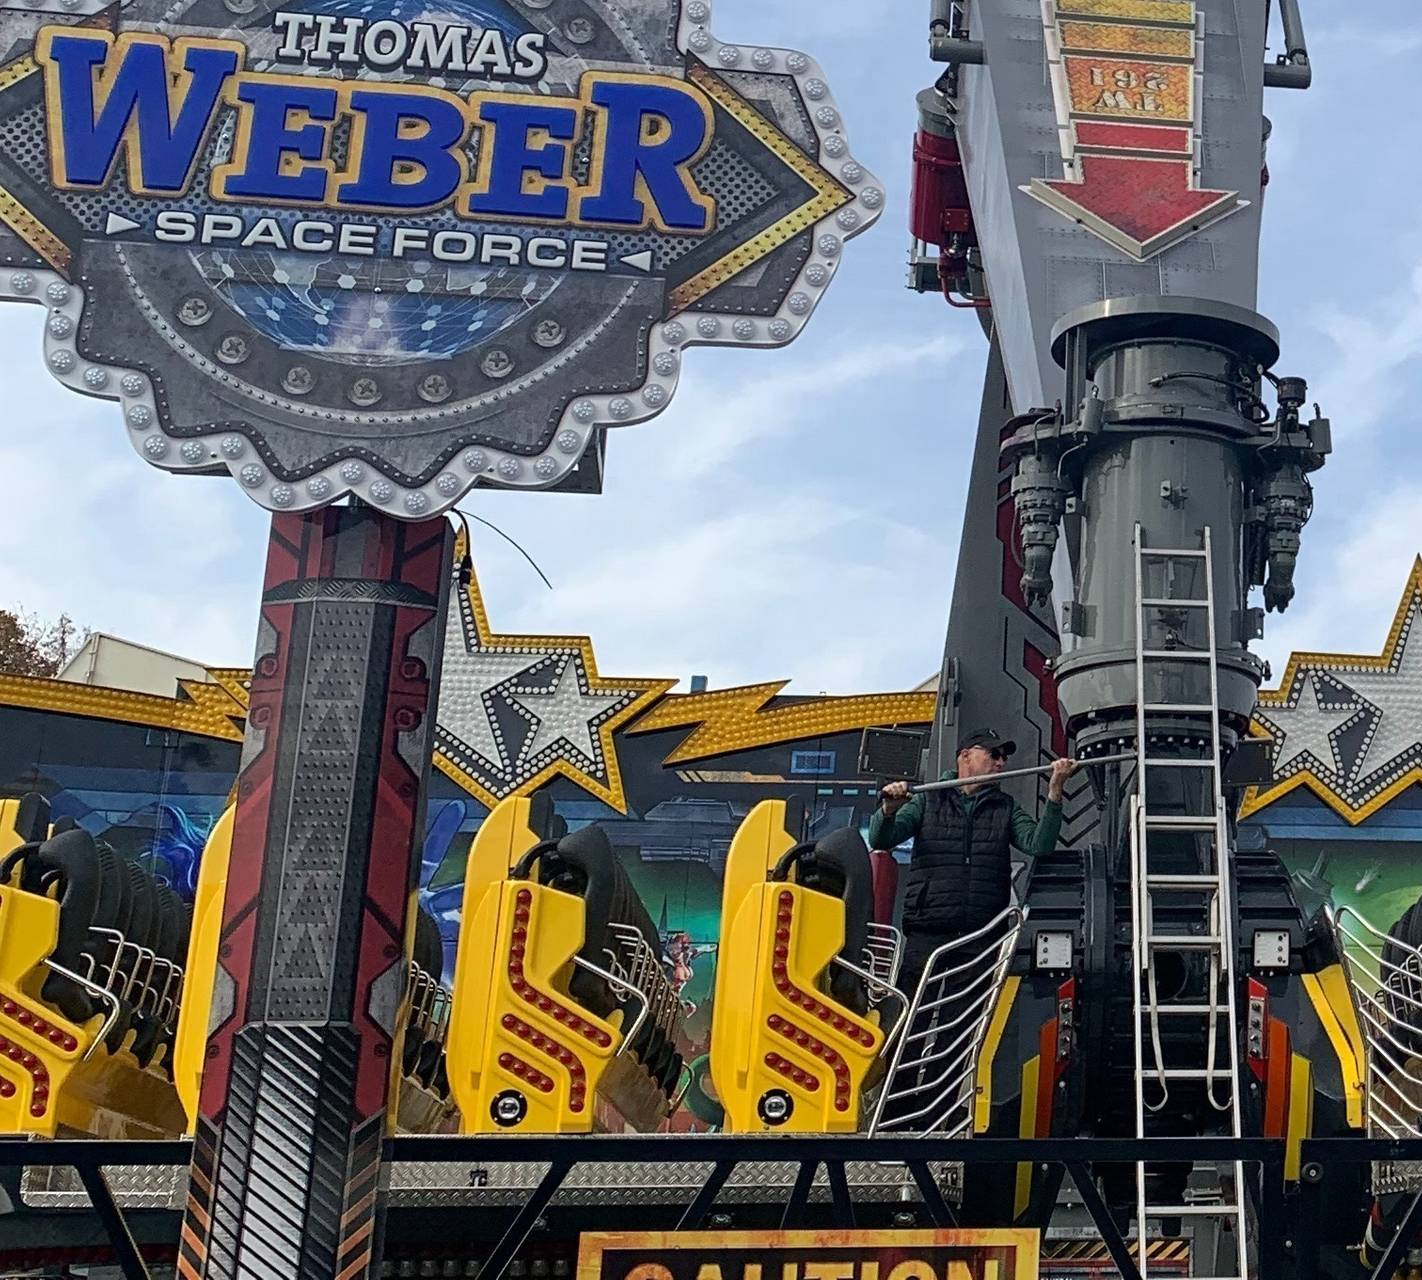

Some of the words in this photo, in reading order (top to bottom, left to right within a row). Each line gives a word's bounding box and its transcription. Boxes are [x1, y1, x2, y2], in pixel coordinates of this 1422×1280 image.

[274, 11, 547, 80] THOMAS
[46, 34, 710, 229] WEBER
[154, 211, 375, 256] SPACE
[391, 223, 608, 272] FORCE
